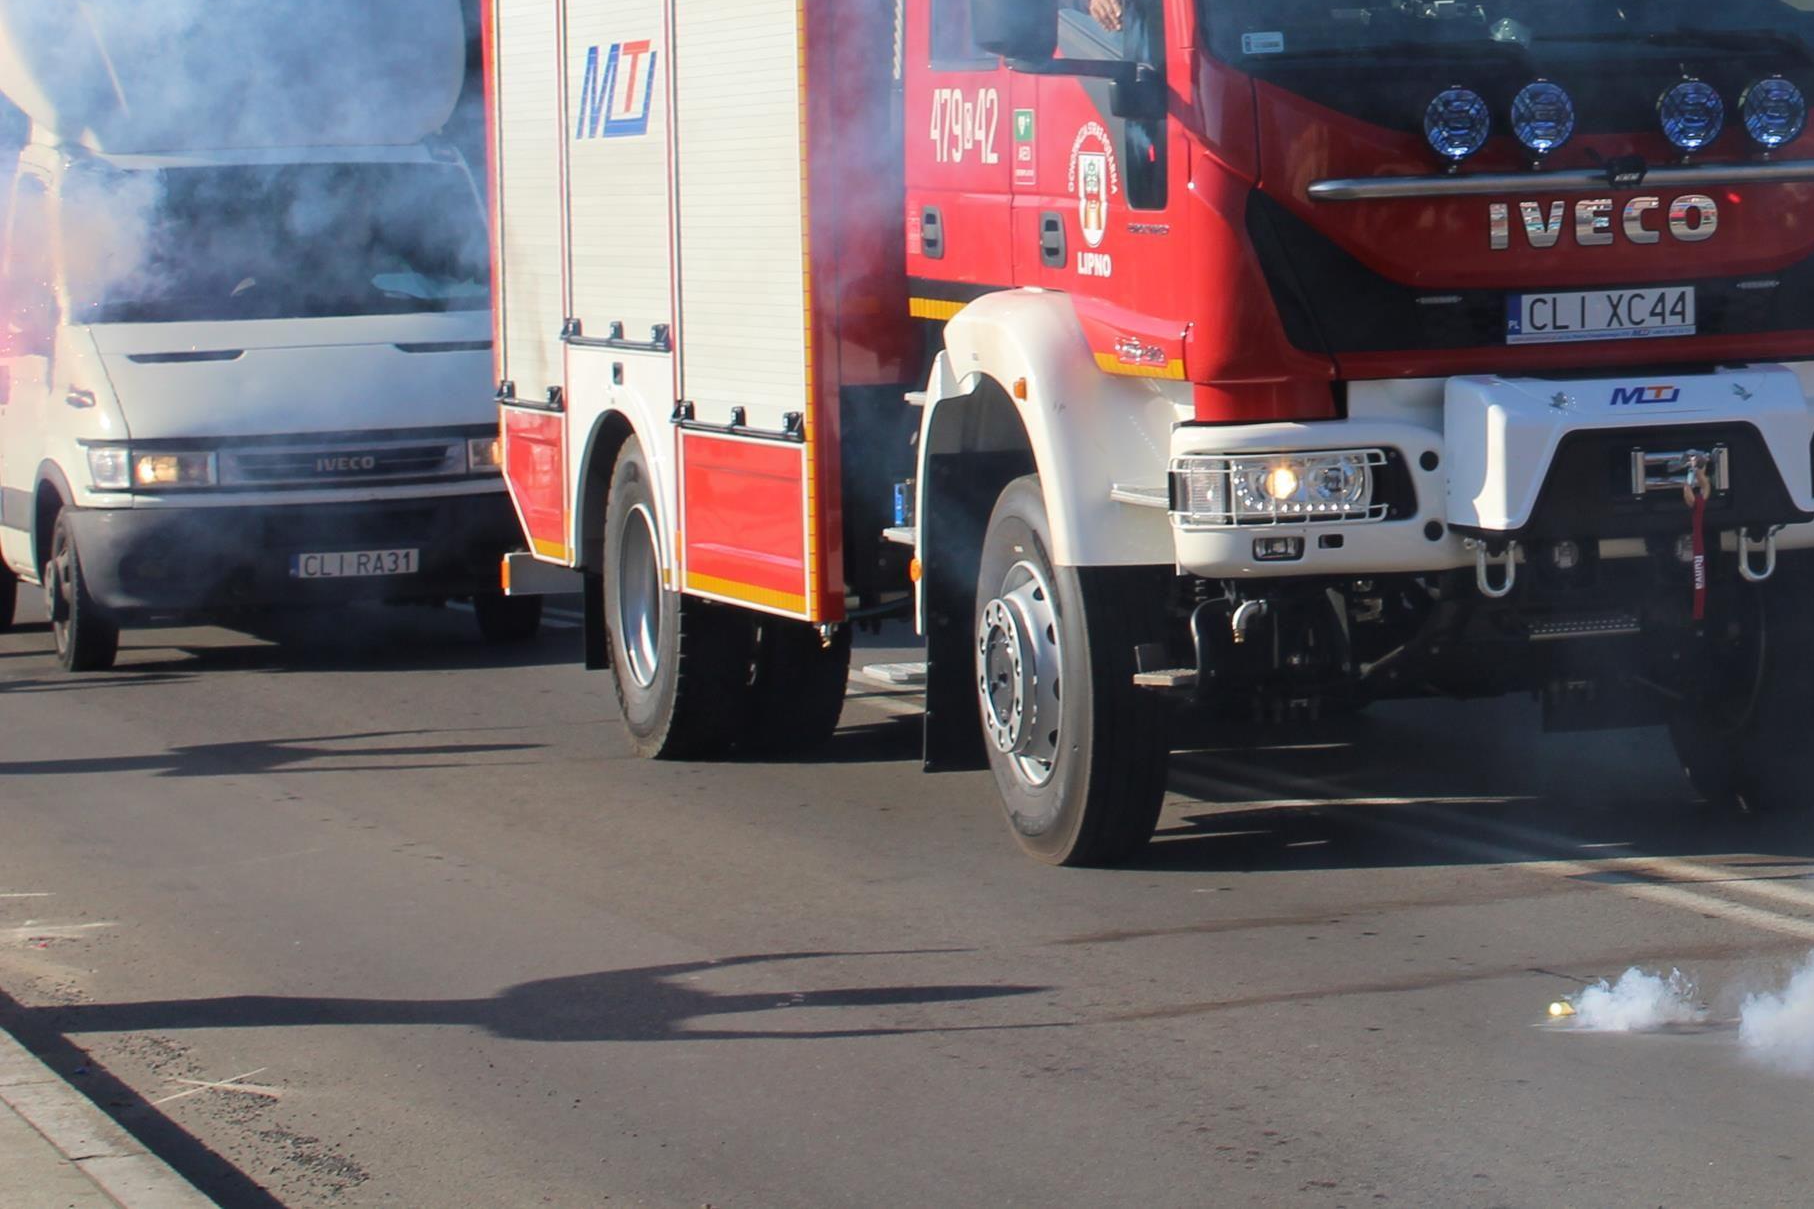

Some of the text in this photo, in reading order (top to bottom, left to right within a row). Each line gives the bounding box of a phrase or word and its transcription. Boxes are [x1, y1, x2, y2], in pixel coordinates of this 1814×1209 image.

[1489, 193, 1719, 250] IVECO
[1077, 251, 1112, 278] LIPNO
[1605, 290, 1687, 327] XC44
[1507, 319, 1521, 330] PL
[315, 455, 376, 472] IVECO
[355, 550, 412, 575] RA31
